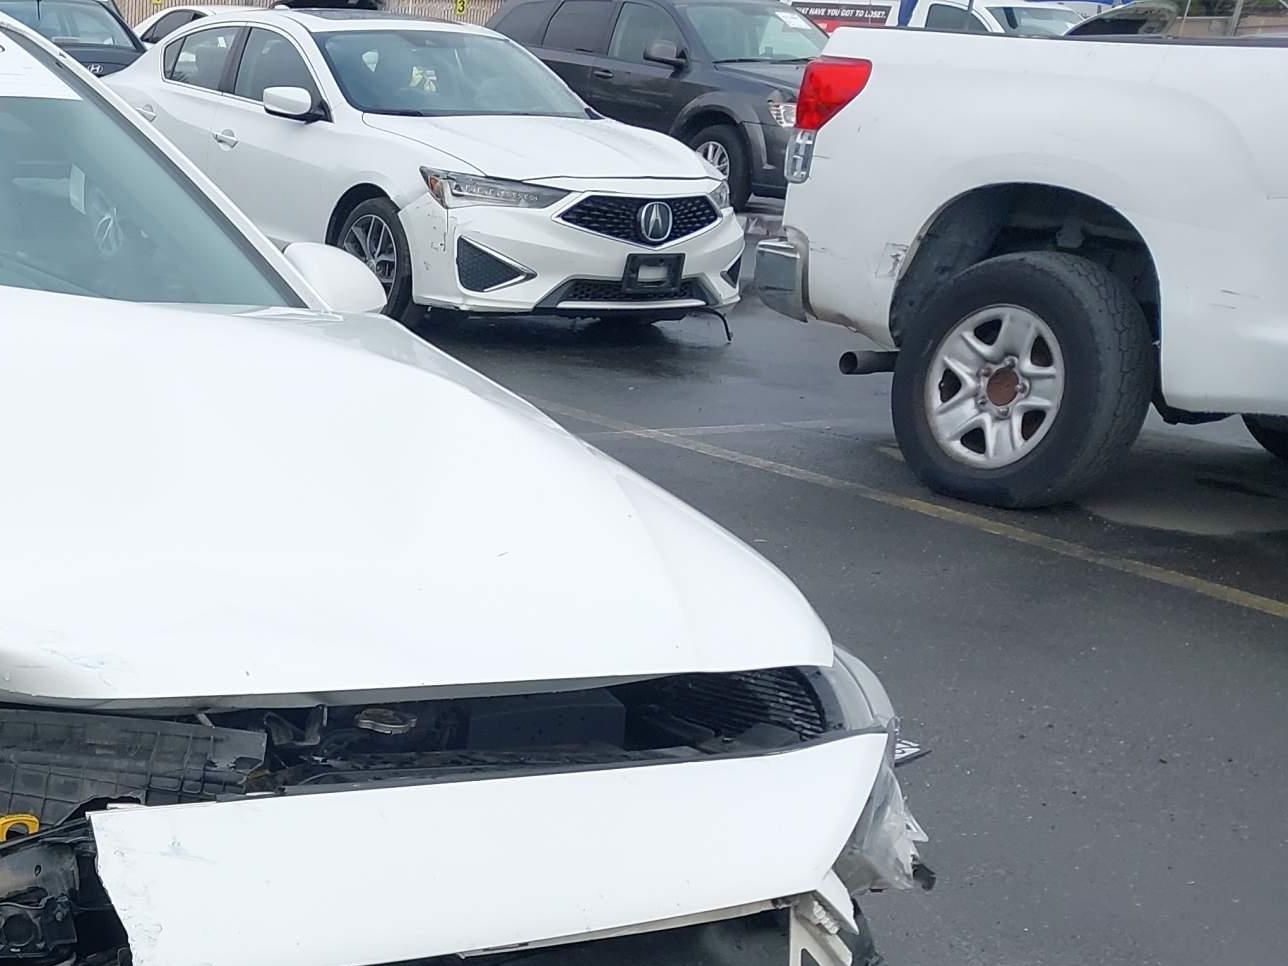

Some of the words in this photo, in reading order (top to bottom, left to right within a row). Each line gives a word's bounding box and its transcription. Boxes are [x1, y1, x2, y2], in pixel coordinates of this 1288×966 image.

[457, 0, 465, 13] 3
[808, 8, 826, 16] HAVE
[827, 8, 841, 17] YOU
[841, 9, 854, 17] GOT
[855, 9, 865, 17] TO
